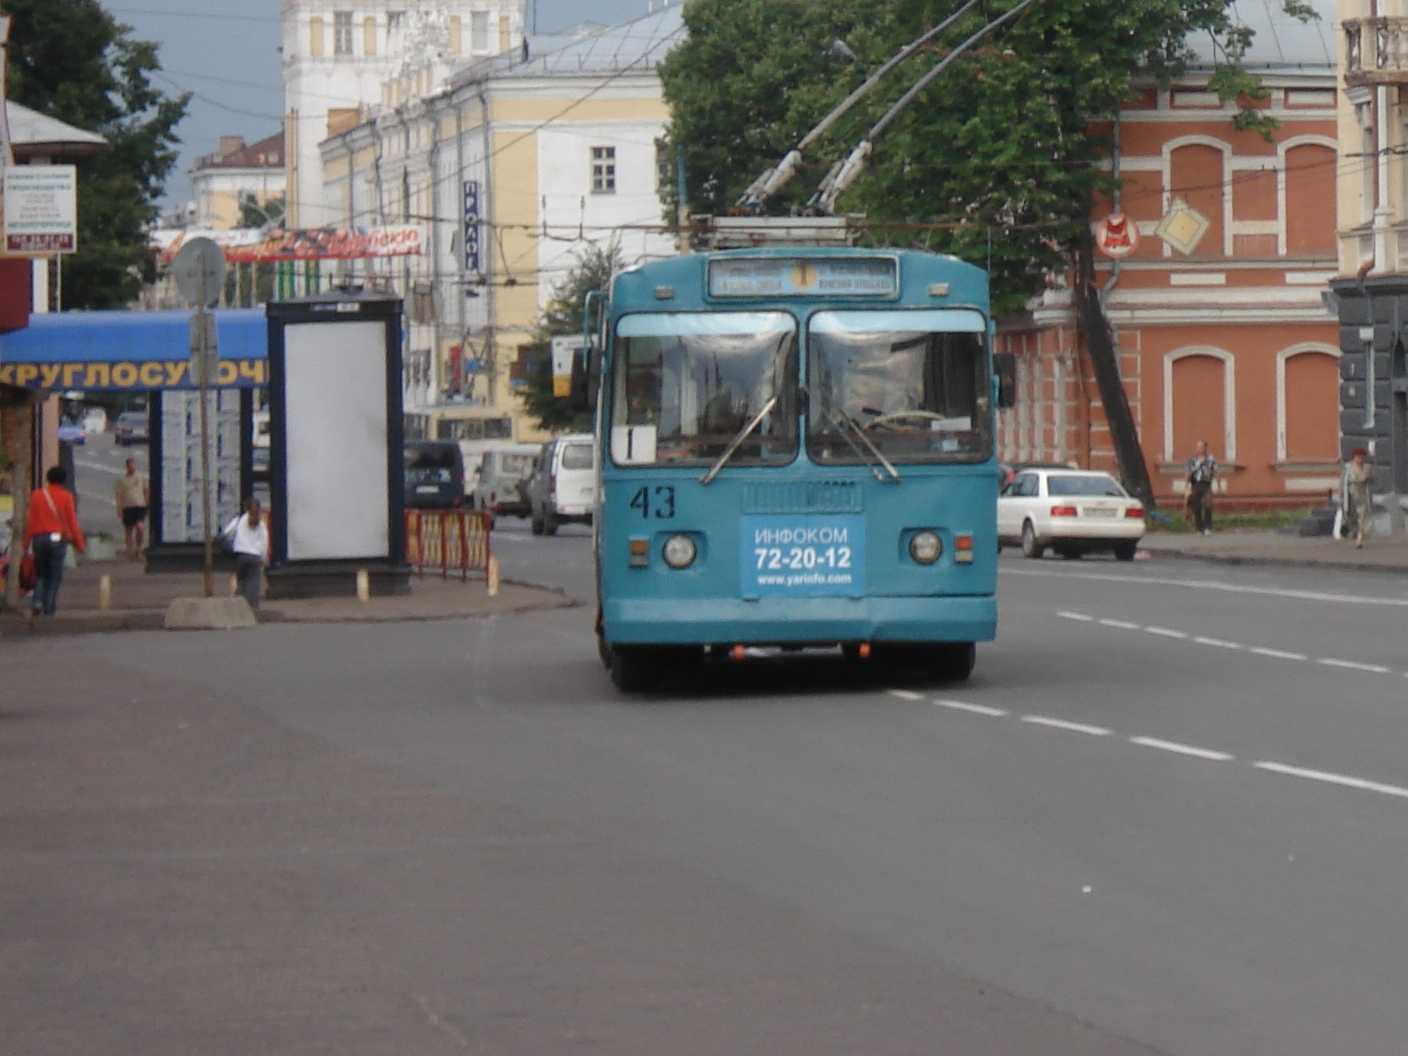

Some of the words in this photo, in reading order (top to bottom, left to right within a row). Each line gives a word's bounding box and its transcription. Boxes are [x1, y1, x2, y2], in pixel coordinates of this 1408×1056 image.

[464, 182, 478, 270] ПРОЛОГ
[630, 486, 675, 519] 43
[755, 527, 848, 544] ИНФОКОМ
[755, 547, 851, 569] 72-20-12
[757, 573, 852, 586] www.yarinfo.com
